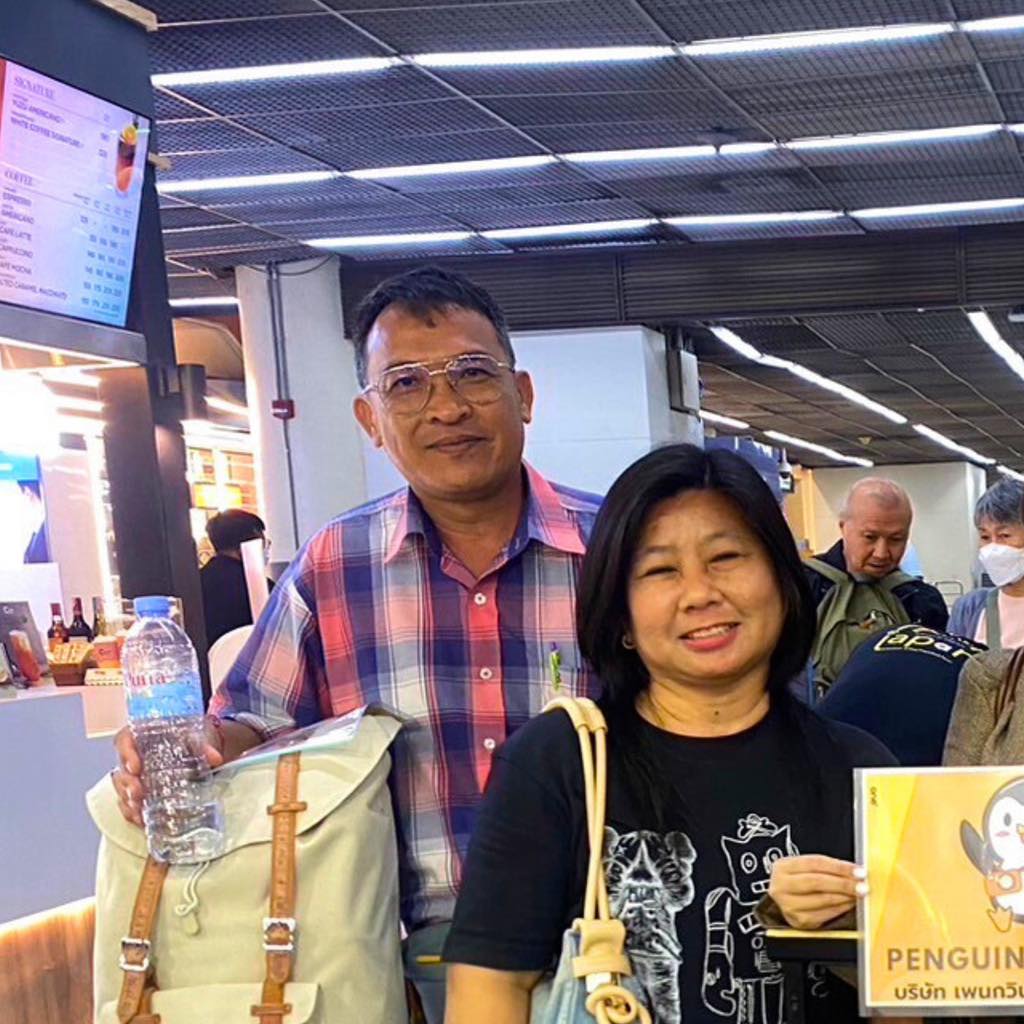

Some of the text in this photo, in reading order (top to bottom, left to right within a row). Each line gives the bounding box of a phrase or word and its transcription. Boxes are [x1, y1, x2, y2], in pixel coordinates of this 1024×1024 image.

[887, 946, 1024, 971] PENGUIN
[894, 982, 946, 1000] บริษัท
